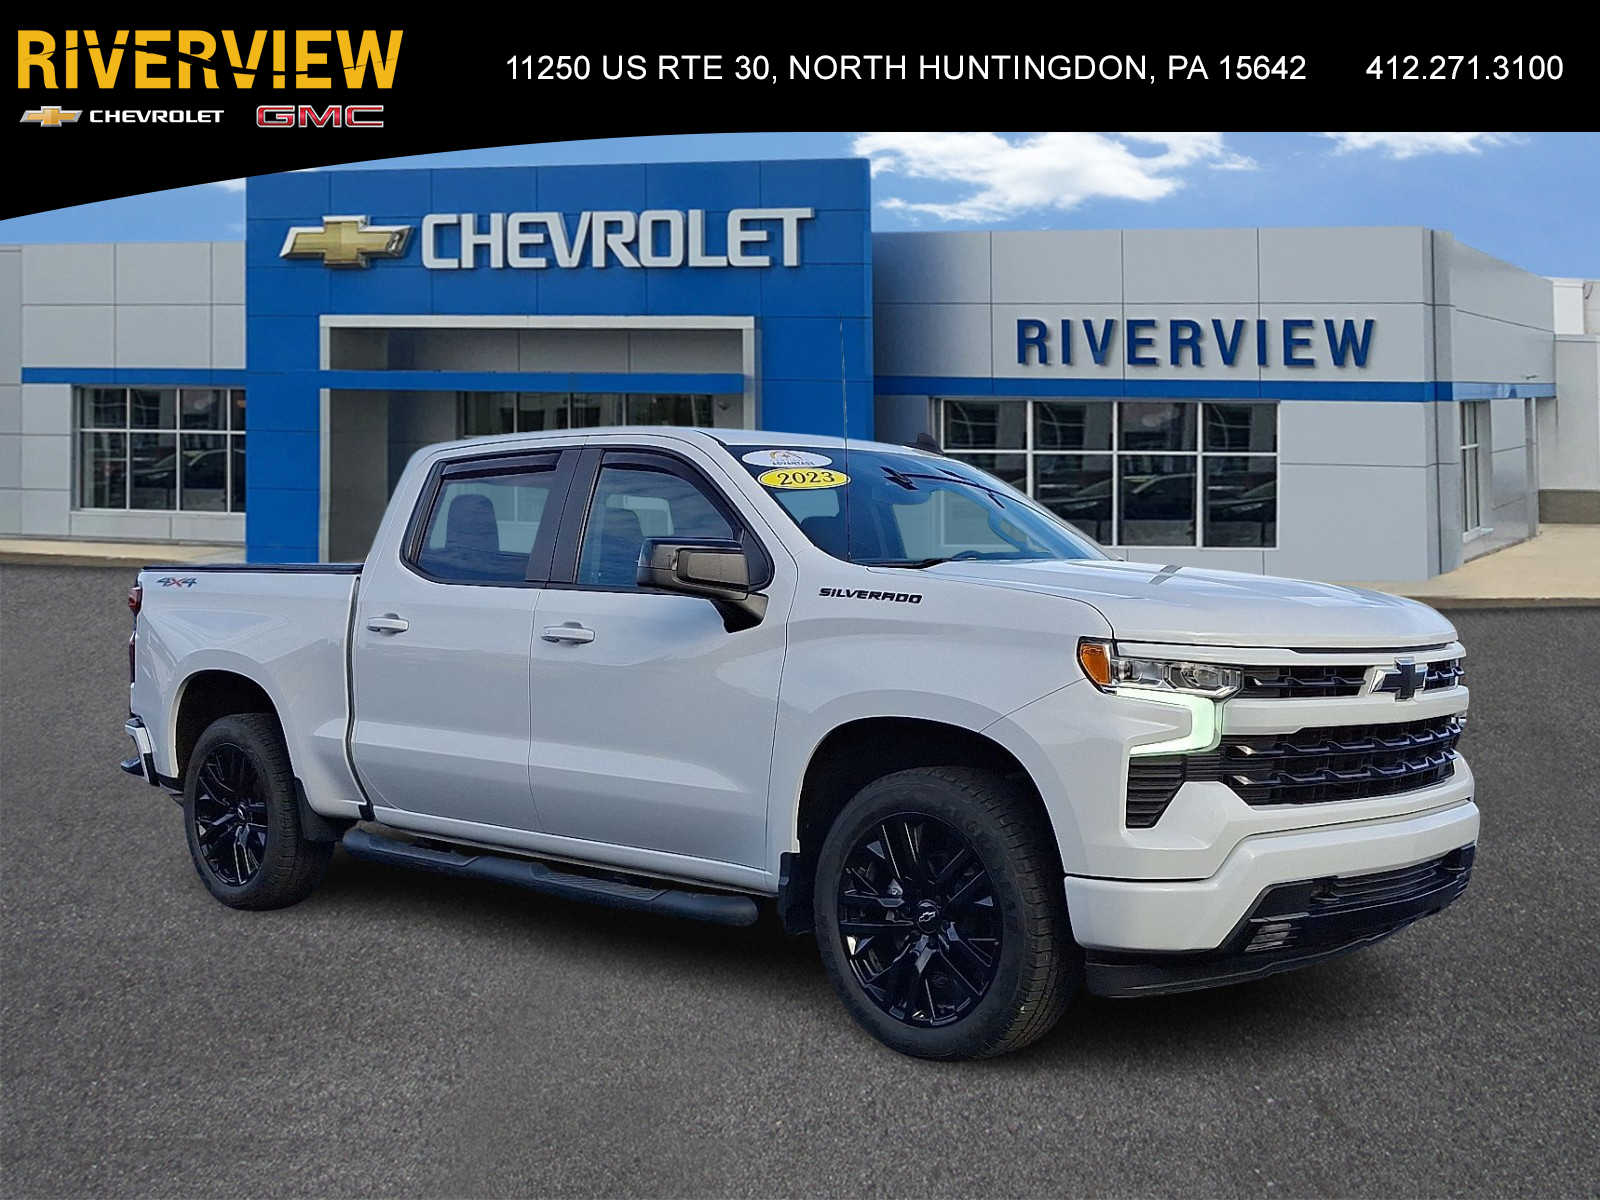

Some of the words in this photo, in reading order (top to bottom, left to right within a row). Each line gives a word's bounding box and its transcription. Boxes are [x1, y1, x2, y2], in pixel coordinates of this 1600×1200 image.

[421, 207, 814, 270] CHEVROLET
[1016, 318, 1376, 368] RIVERVIEW
[776, 471, 835, 485] 2023
[819, 588, 923, 604] SILVERADO
